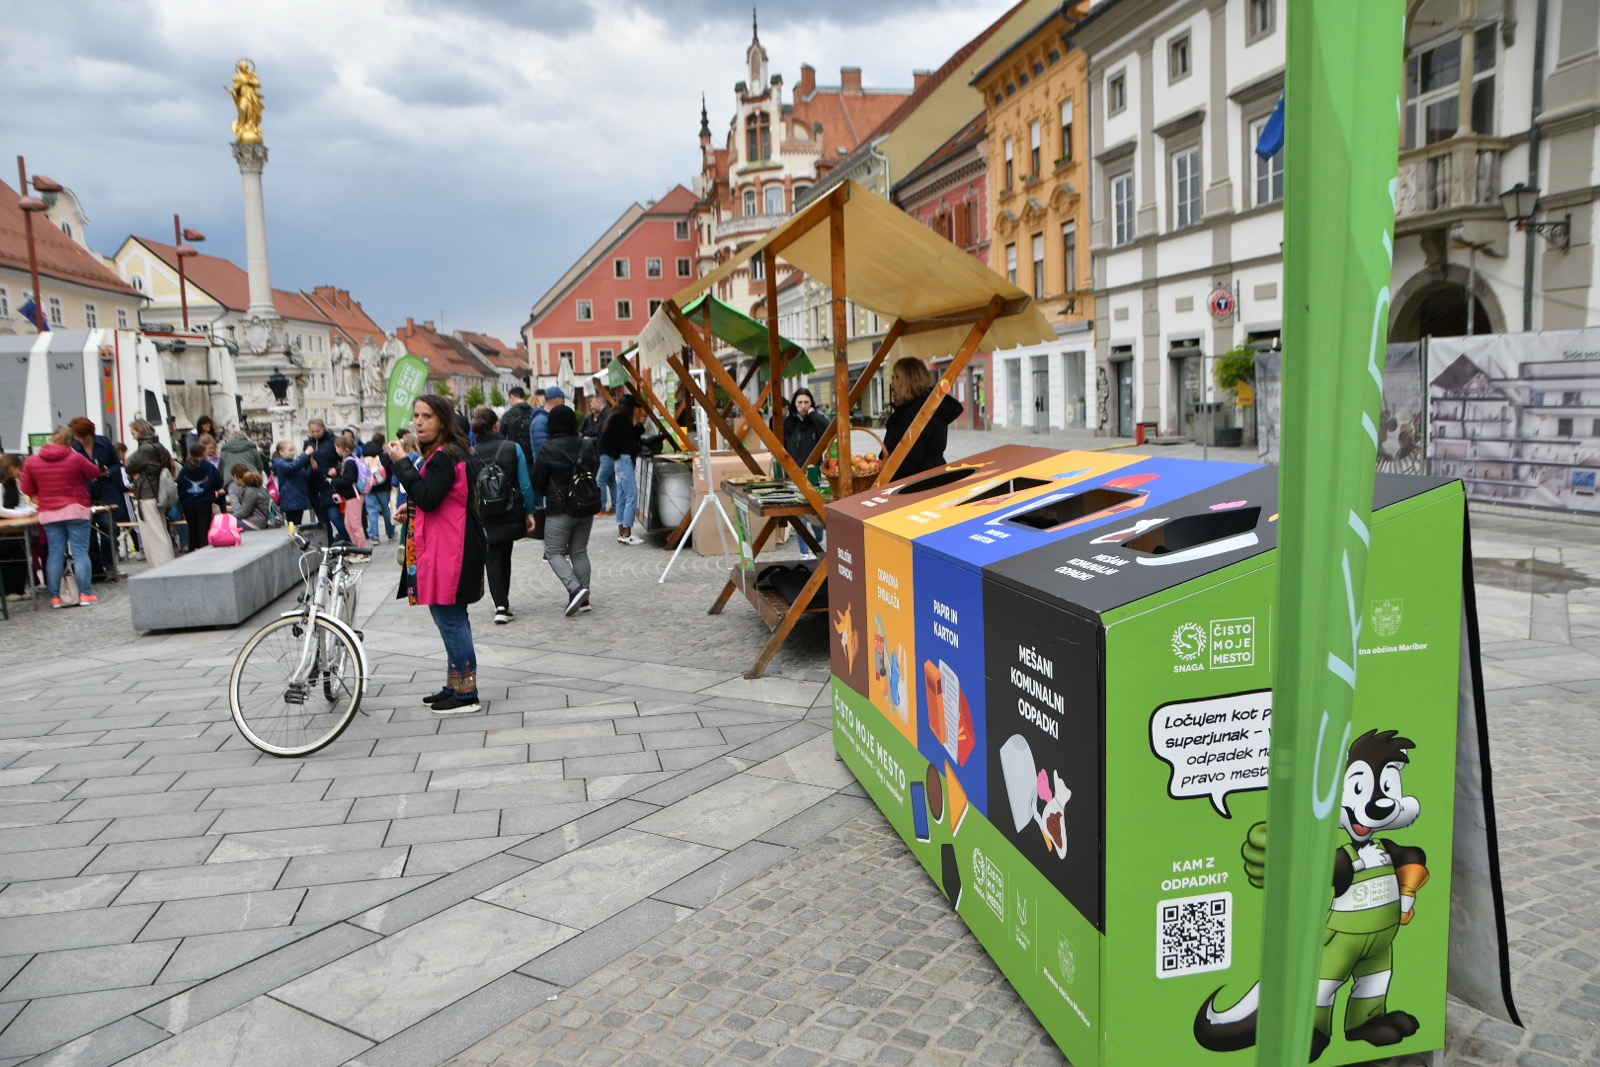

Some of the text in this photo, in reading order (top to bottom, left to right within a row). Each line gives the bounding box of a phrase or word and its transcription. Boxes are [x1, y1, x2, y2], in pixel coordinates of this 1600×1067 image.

[933, 599, 958, 625] PAPIR IN
[933, 621, 959, 648] KARTON
[1213, 623, 1251, 637] ČISTO
[1213, 638, 1251, 651] MOJE
[1372, 645, 1397, 654] občina
[1398, 642, 1428, 651] Maribor
[1018, 644, 1053, 679] MEŠANI
[1173, 663, 1204, 673] SNAGA
[1213, 652, 1251, 665] MESTO
[1010, 666, 1064, 714] KOMUNALNI
[1018, 698, 1059, 740] ODPADKI
[1164, 712, 1227, 729] Ločujem
[1230, 708, 1259, 721] kot
[834, 688, 854, 729] ČISTO
[855, 716, 875, 755] MOJE
[876, 741, 906, 791] MESTO
[1165, 728, 1250, 749] superjunak
[1186, 747, 1254, 766] odpadek
[1181, 771, 1226, 788] pravo
[1172, 856, 1215, 873] KAM Z
[987, 877, 1003, 902] MOJE
[1161, 872, 1229, 891] ODPADKI?
[1372, 880, 1391, 889] ČISTO
[987, 890, 1003, 916] MESTO
[1372, 894, 1391, 902] MESTO
